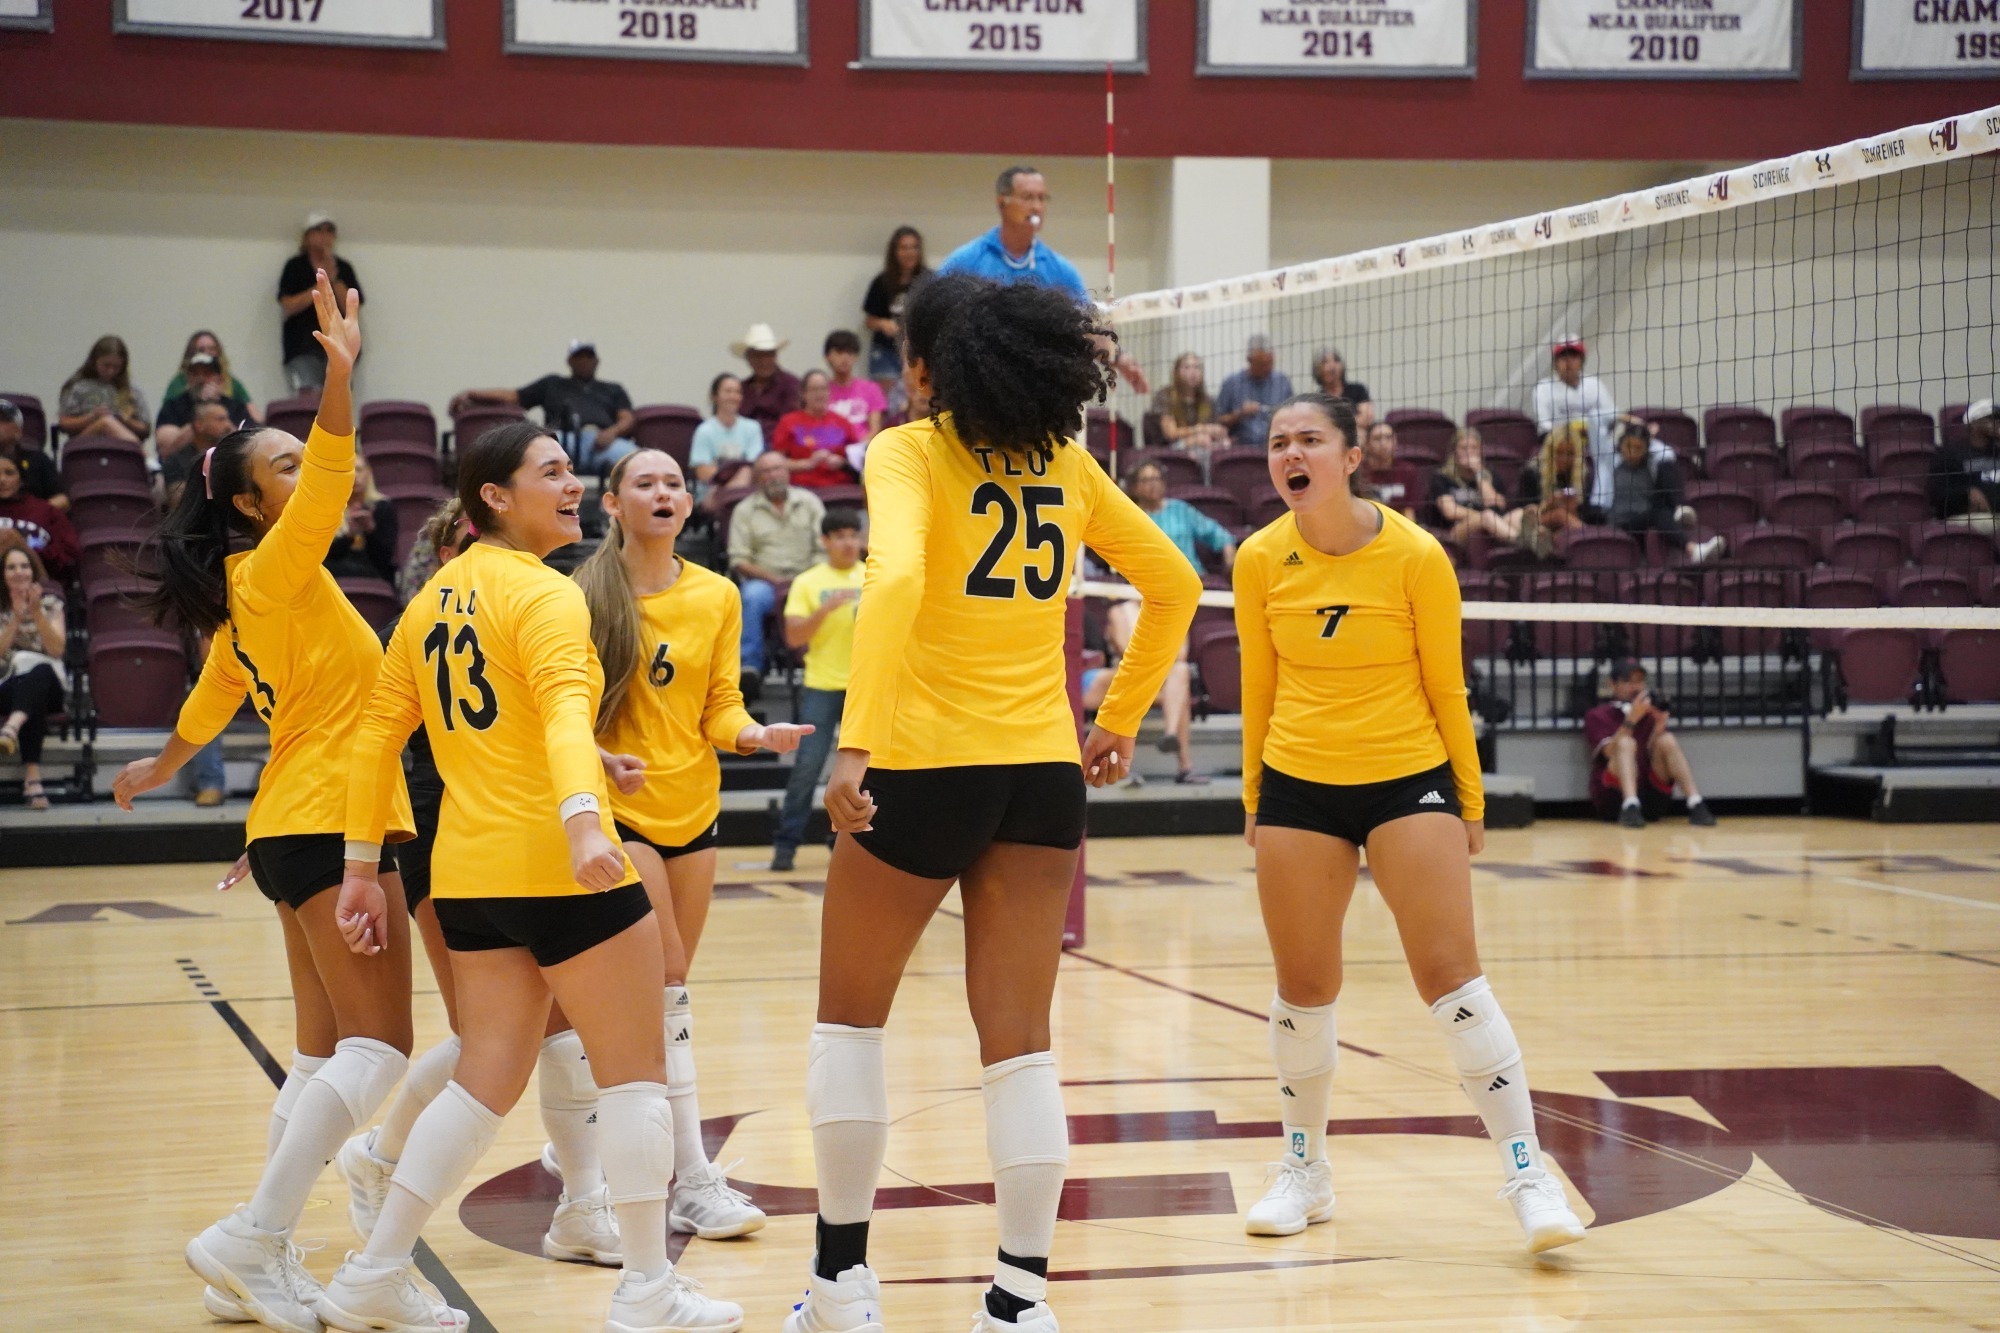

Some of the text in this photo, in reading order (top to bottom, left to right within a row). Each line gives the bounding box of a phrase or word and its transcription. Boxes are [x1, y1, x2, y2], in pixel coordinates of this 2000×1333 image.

[241, 0, 324, 22] 2017
[1260, 9, 1311, 24] NCAA
[1589, 14, 1638, 28] NCAA
[1913, 0, 2000, 23] CHAM
[620, 11, 697, 39] 2018
[969, 24, 1042, 50] 2015
[1303, 31, 1372, 57] 2014
[1629, 35, 1699, 60] 2010
[1955, 33, 2000, 59] 199
[1861, 139, 1906, 164] SCHREINER
[1986, 116, 2000, 136] SC
[965, 481, 1065, 601] 25
[1316, 604, 1350, 638] 7
[424, 622, 499, 731] 13
[648, 643, 675, 688] 6
